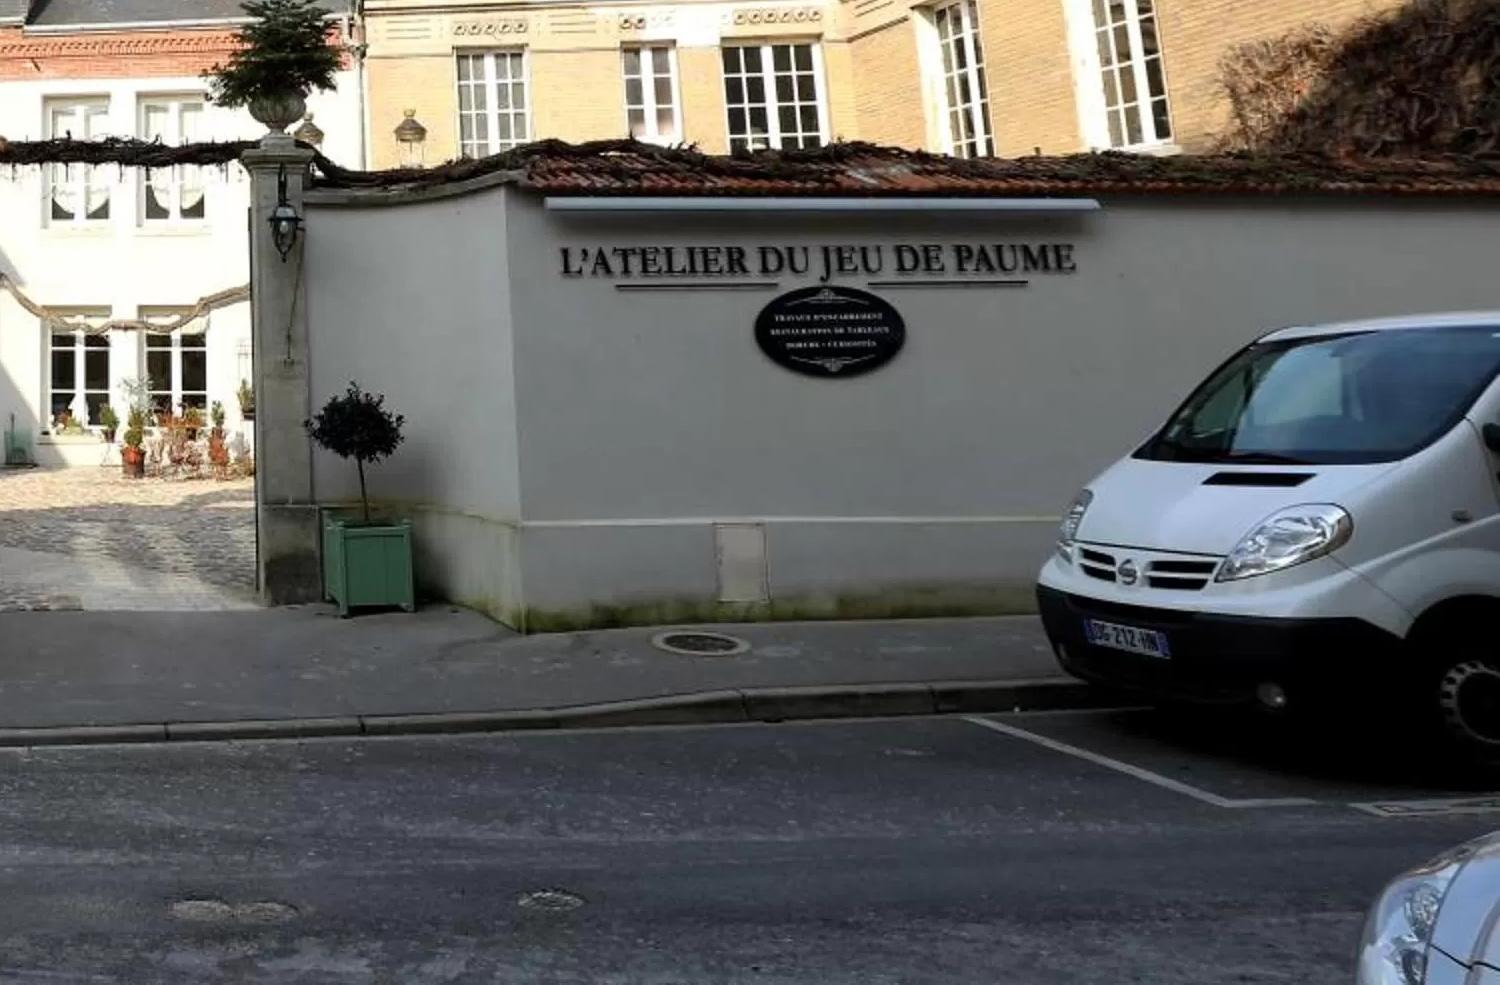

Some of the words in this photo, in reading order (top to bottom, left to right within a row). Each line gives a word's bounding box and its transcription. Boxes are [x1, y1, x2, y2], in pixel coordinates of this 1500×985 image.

[560, 246, 750, 276] L'ATELIER
[756, 246, 810, 276] DU
[820, 244, 883, 282] JEU
[893, 244, 945, 274] DE
[951, 243, 1077, 274] PAUME
